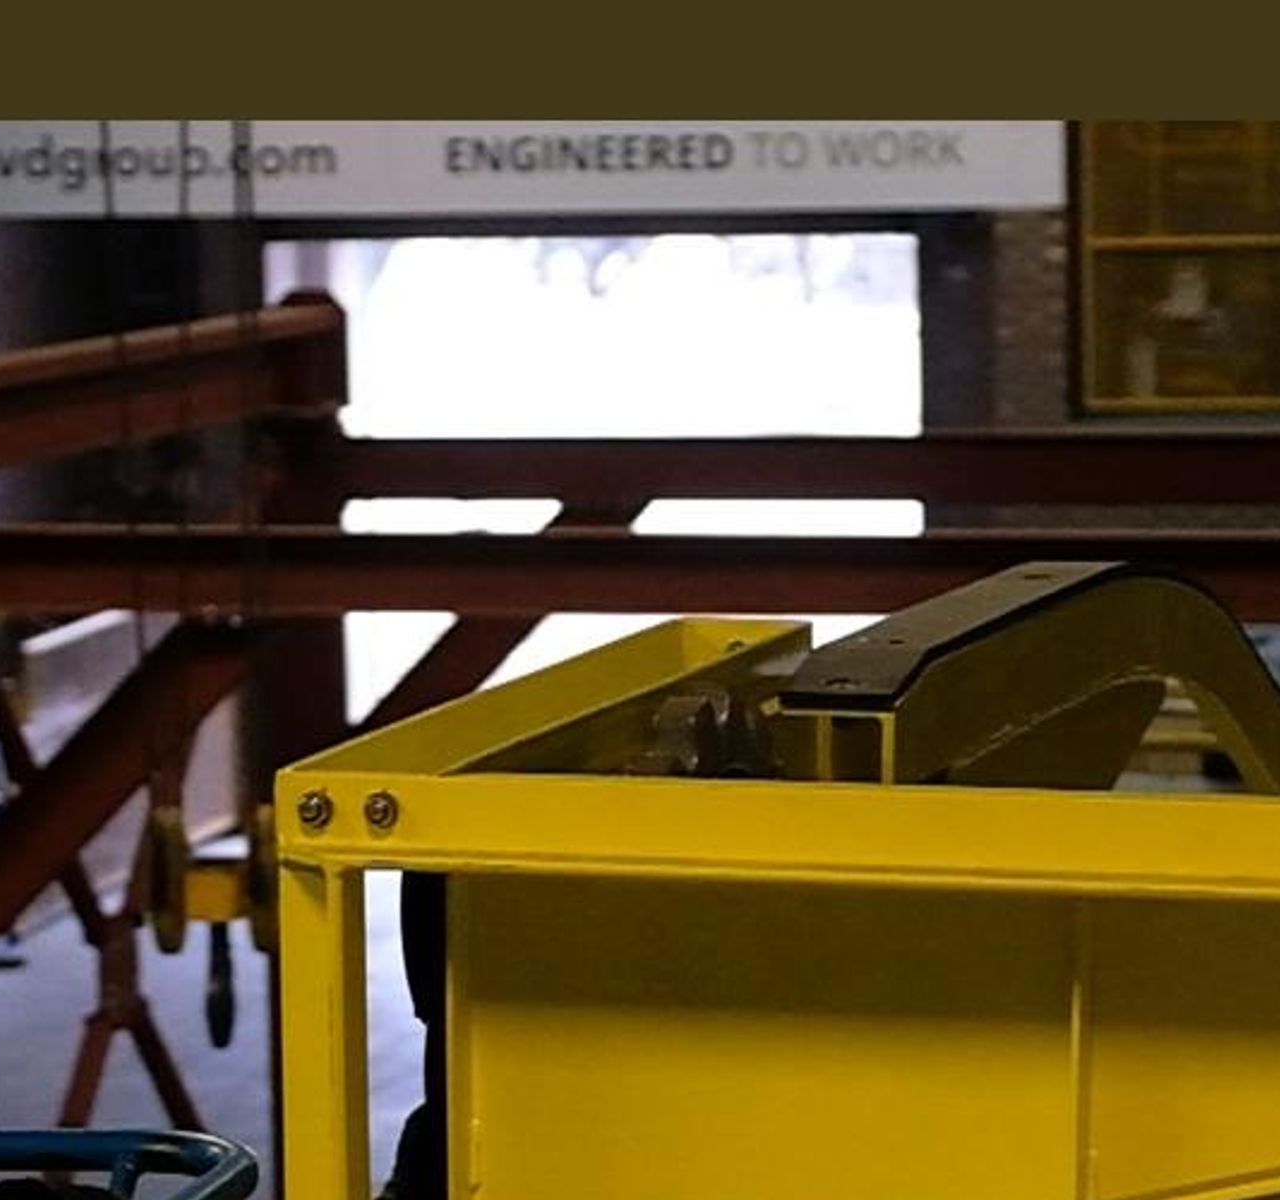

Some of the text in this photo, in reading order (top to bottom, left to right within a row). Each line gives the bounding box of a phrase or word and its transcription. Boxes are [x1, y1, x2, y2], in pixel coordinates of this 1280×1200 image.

[445, 129, 965, 173] ENGINEERED TO WORK
